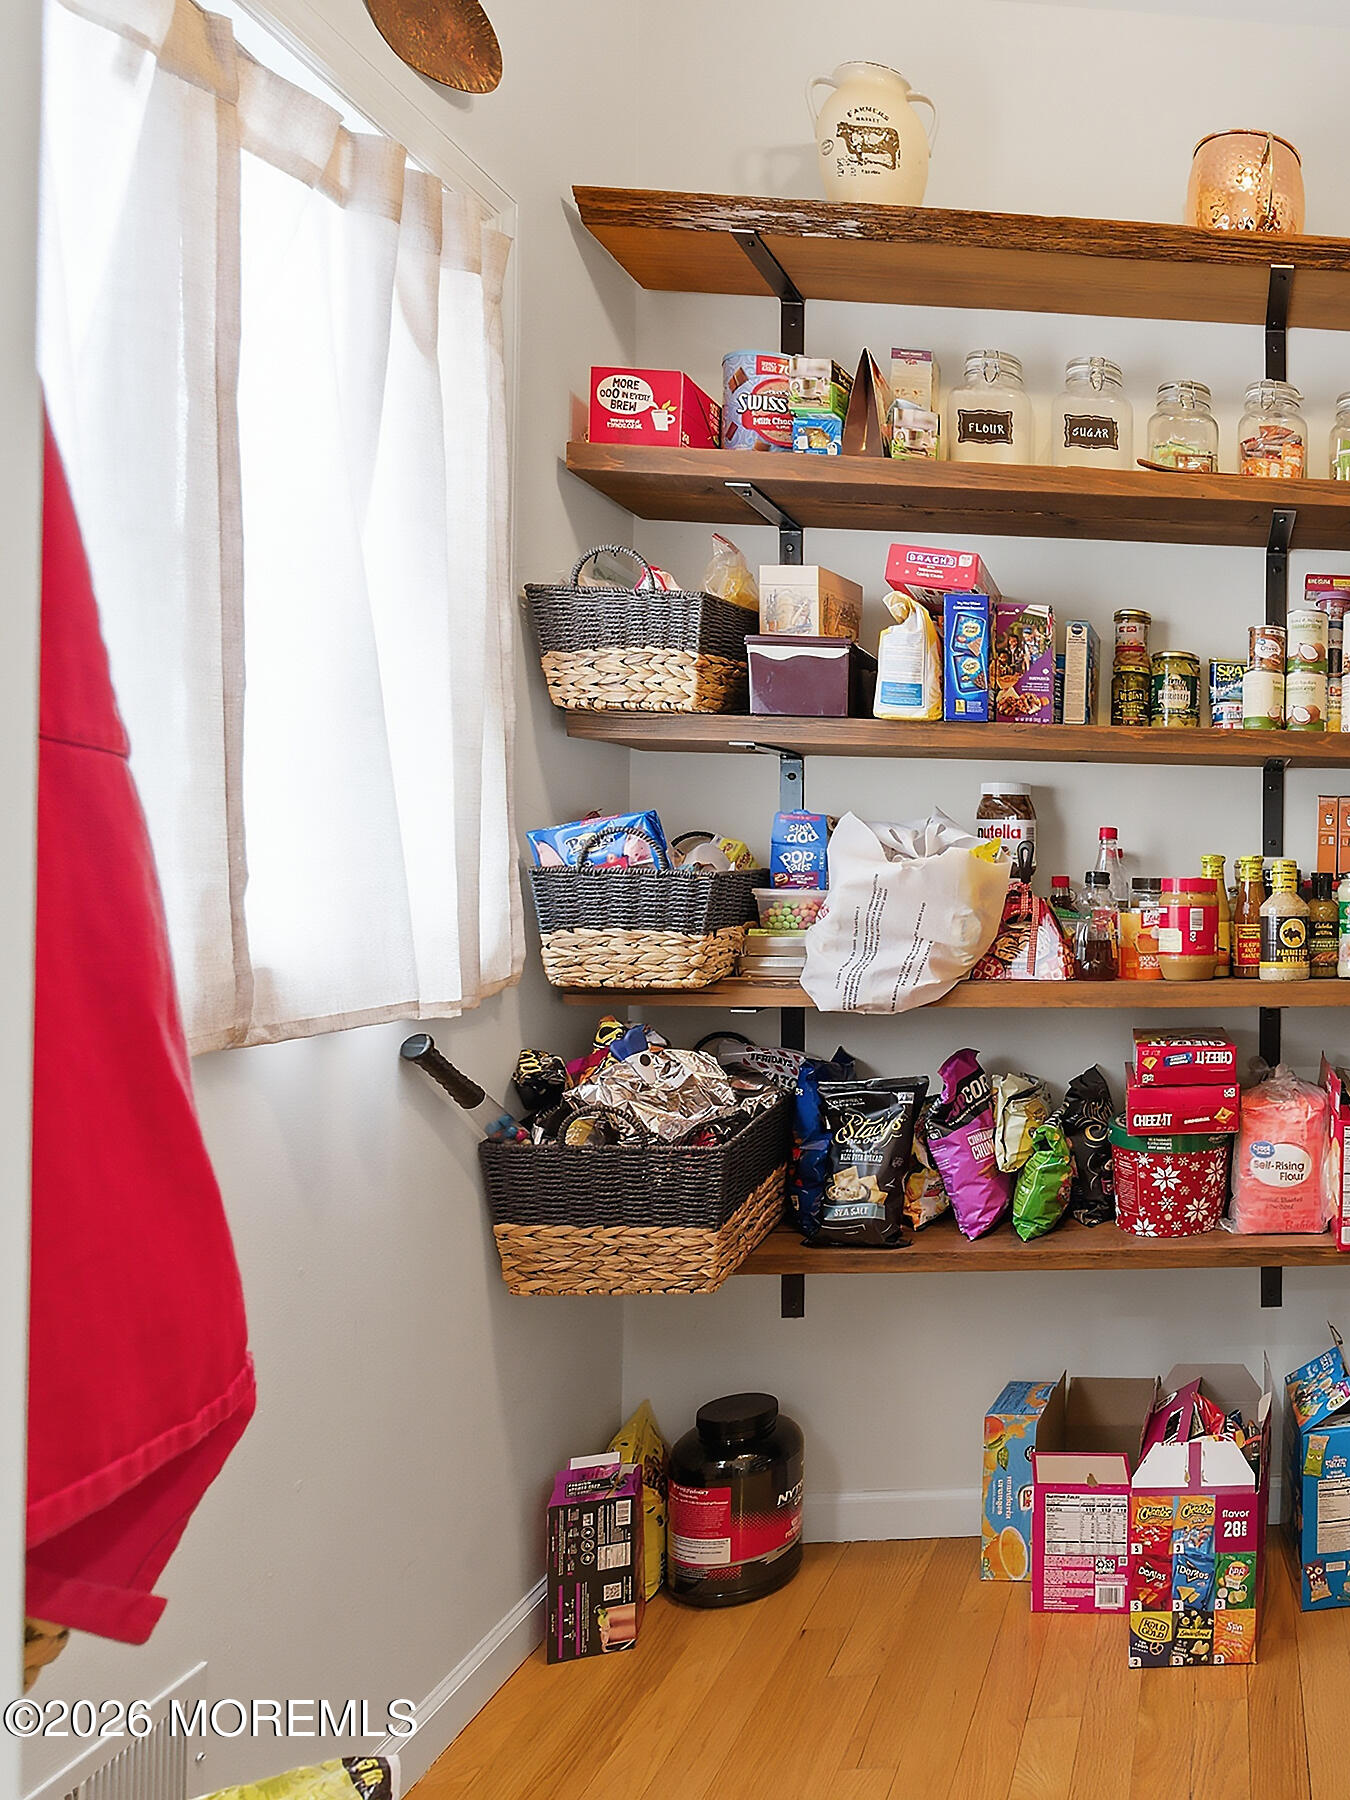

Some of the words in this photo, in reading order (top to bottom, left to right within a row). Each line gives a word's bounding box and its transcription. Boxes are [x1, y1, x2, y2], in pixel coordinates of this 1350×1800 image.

[612, 377, 640, 390] MORE
[610, 399, 637, 412] BREW
[736, 392, 790, 415] SWISS
[968, 421, 1006, 435] FLOUR
[1071, 425, 1109, 439] SUGAR
[1217, 664, 1248, 678] SPA
[977, 824, 1022, 840] nutella
[835, 1112, 905, 1144] Stacy's
[1253, 1160, 1305, 1172] Self-Rising
[1279, 1172, 1305, 1181] Flour
[833, 1208, 850, 1217] SEA
[850, 1207, 869, 1216] SALT
[1136, 1505, 1174, 1521] Cheetos
[1180, 1502, 1215, 1520] Cheetos
[1222, 1509, 1250, 1518] flavor
[1138, 1566, 1167, 1581] Doritos
[1176, 1564, 1209, 1580] Doritos
[1141, 1627, 1165, 1639] GOLD
[1143, 1620, 1167, 1632] ROLD
